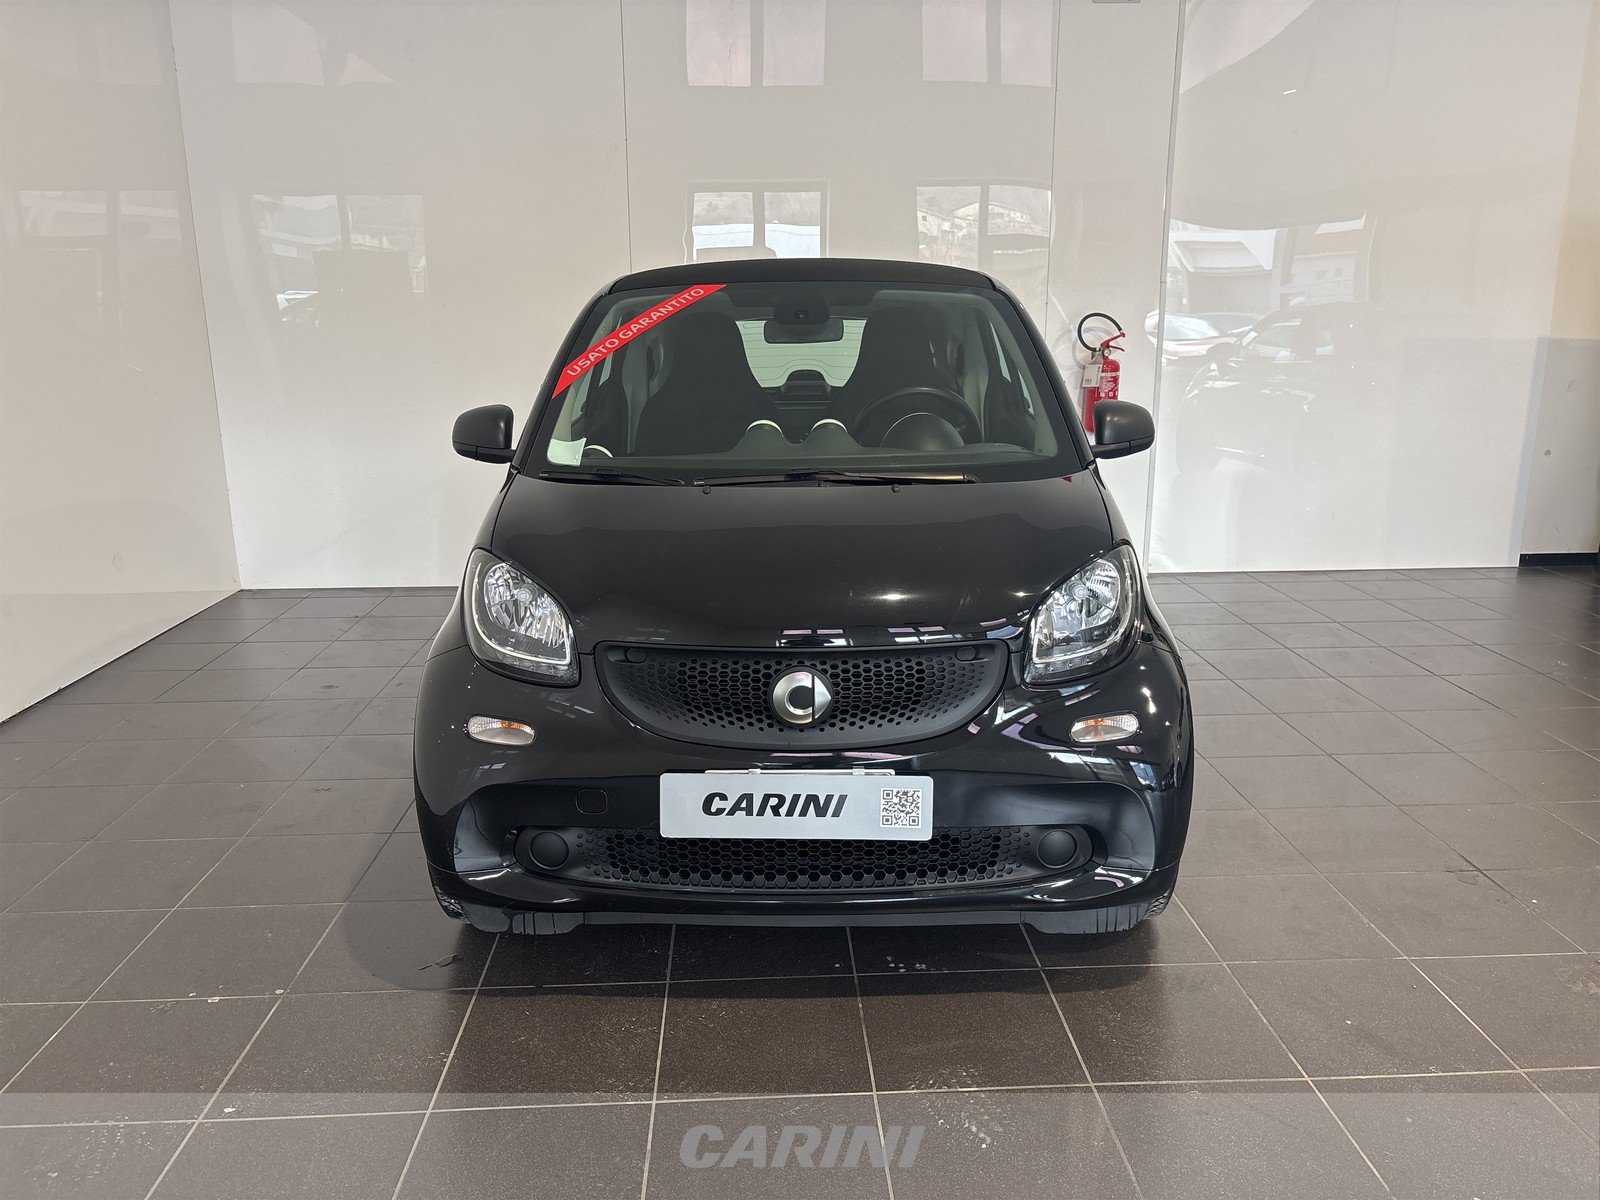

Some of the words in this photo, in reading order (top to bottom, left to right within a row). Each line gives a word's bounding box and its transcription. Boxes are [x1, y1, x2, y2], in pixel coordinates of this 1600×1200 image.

[566, 338, 619, 376] USATO
[618, 287, 705, 340] GARANTITO
[701, 792, 848, 818] CARINI
